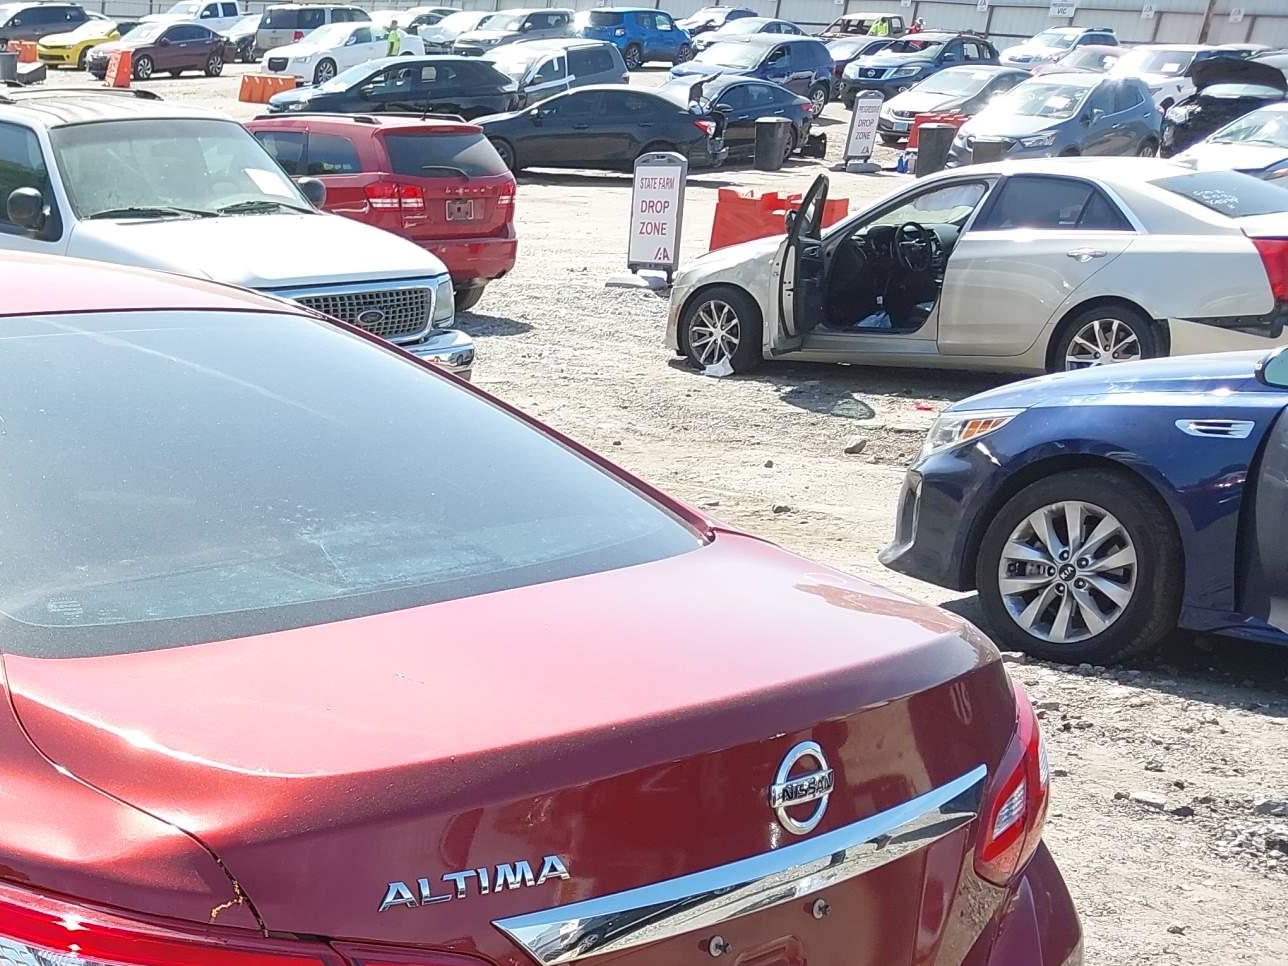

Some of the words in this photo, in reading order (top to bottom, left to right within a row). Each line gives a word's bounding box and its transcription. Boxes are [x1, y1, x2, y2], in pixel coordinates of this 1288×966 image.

[857, 119, 875, 127] DROP
[855, 131, 871, 140] ZONE
[639, 177, 657, 190] STATE
[658, 177, 675, 190] FARM
[640, 200, 670, 213] DROP
[639, 222, 667, 235] ZONE
[781, 772, 833, 802] NISSAN
[378, 854, 571, 912] ALTIMA
